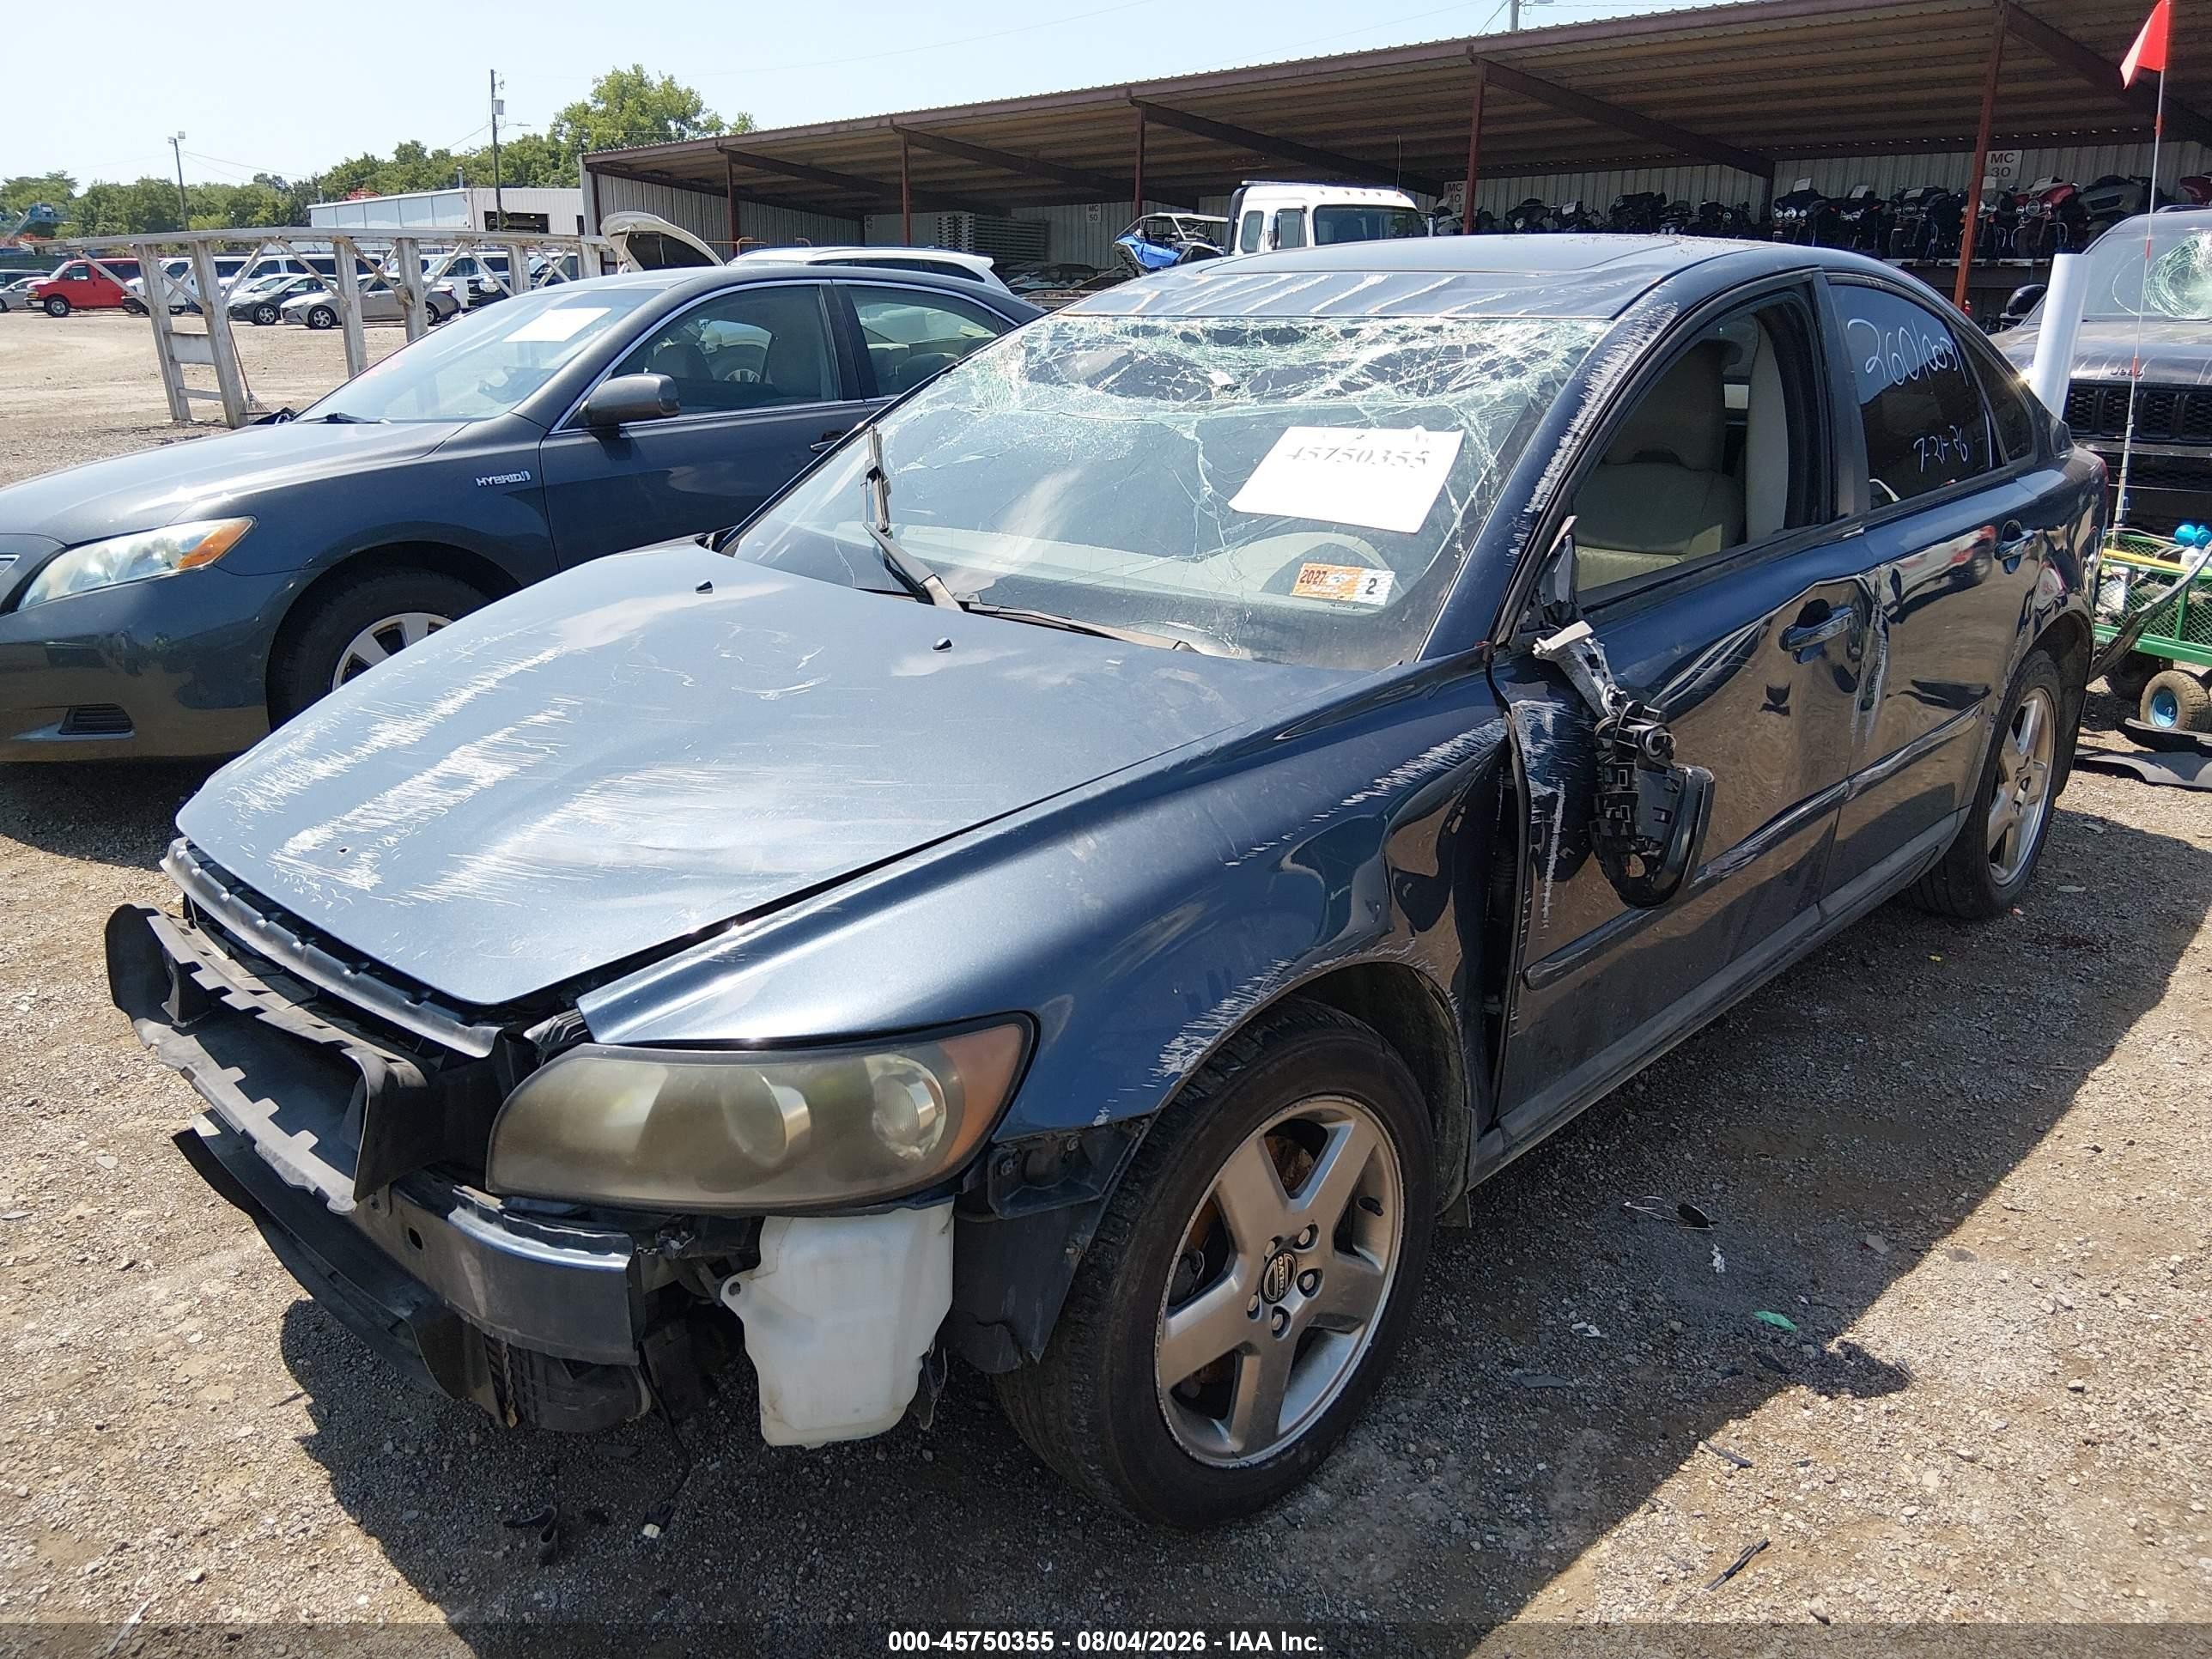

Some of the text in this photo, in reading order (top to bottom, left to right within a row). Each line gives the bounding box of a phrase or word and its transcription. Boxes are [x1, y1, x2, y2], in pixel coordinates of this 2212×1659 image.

[1990, 152, 2014, 163] MC
[1991, 167, 2011, 177] 30
[1447, 183, 1463, 192] MC
[475, 473, 522, 487] HYBRID
[1299, 568, 1378, 595] 2027 2
